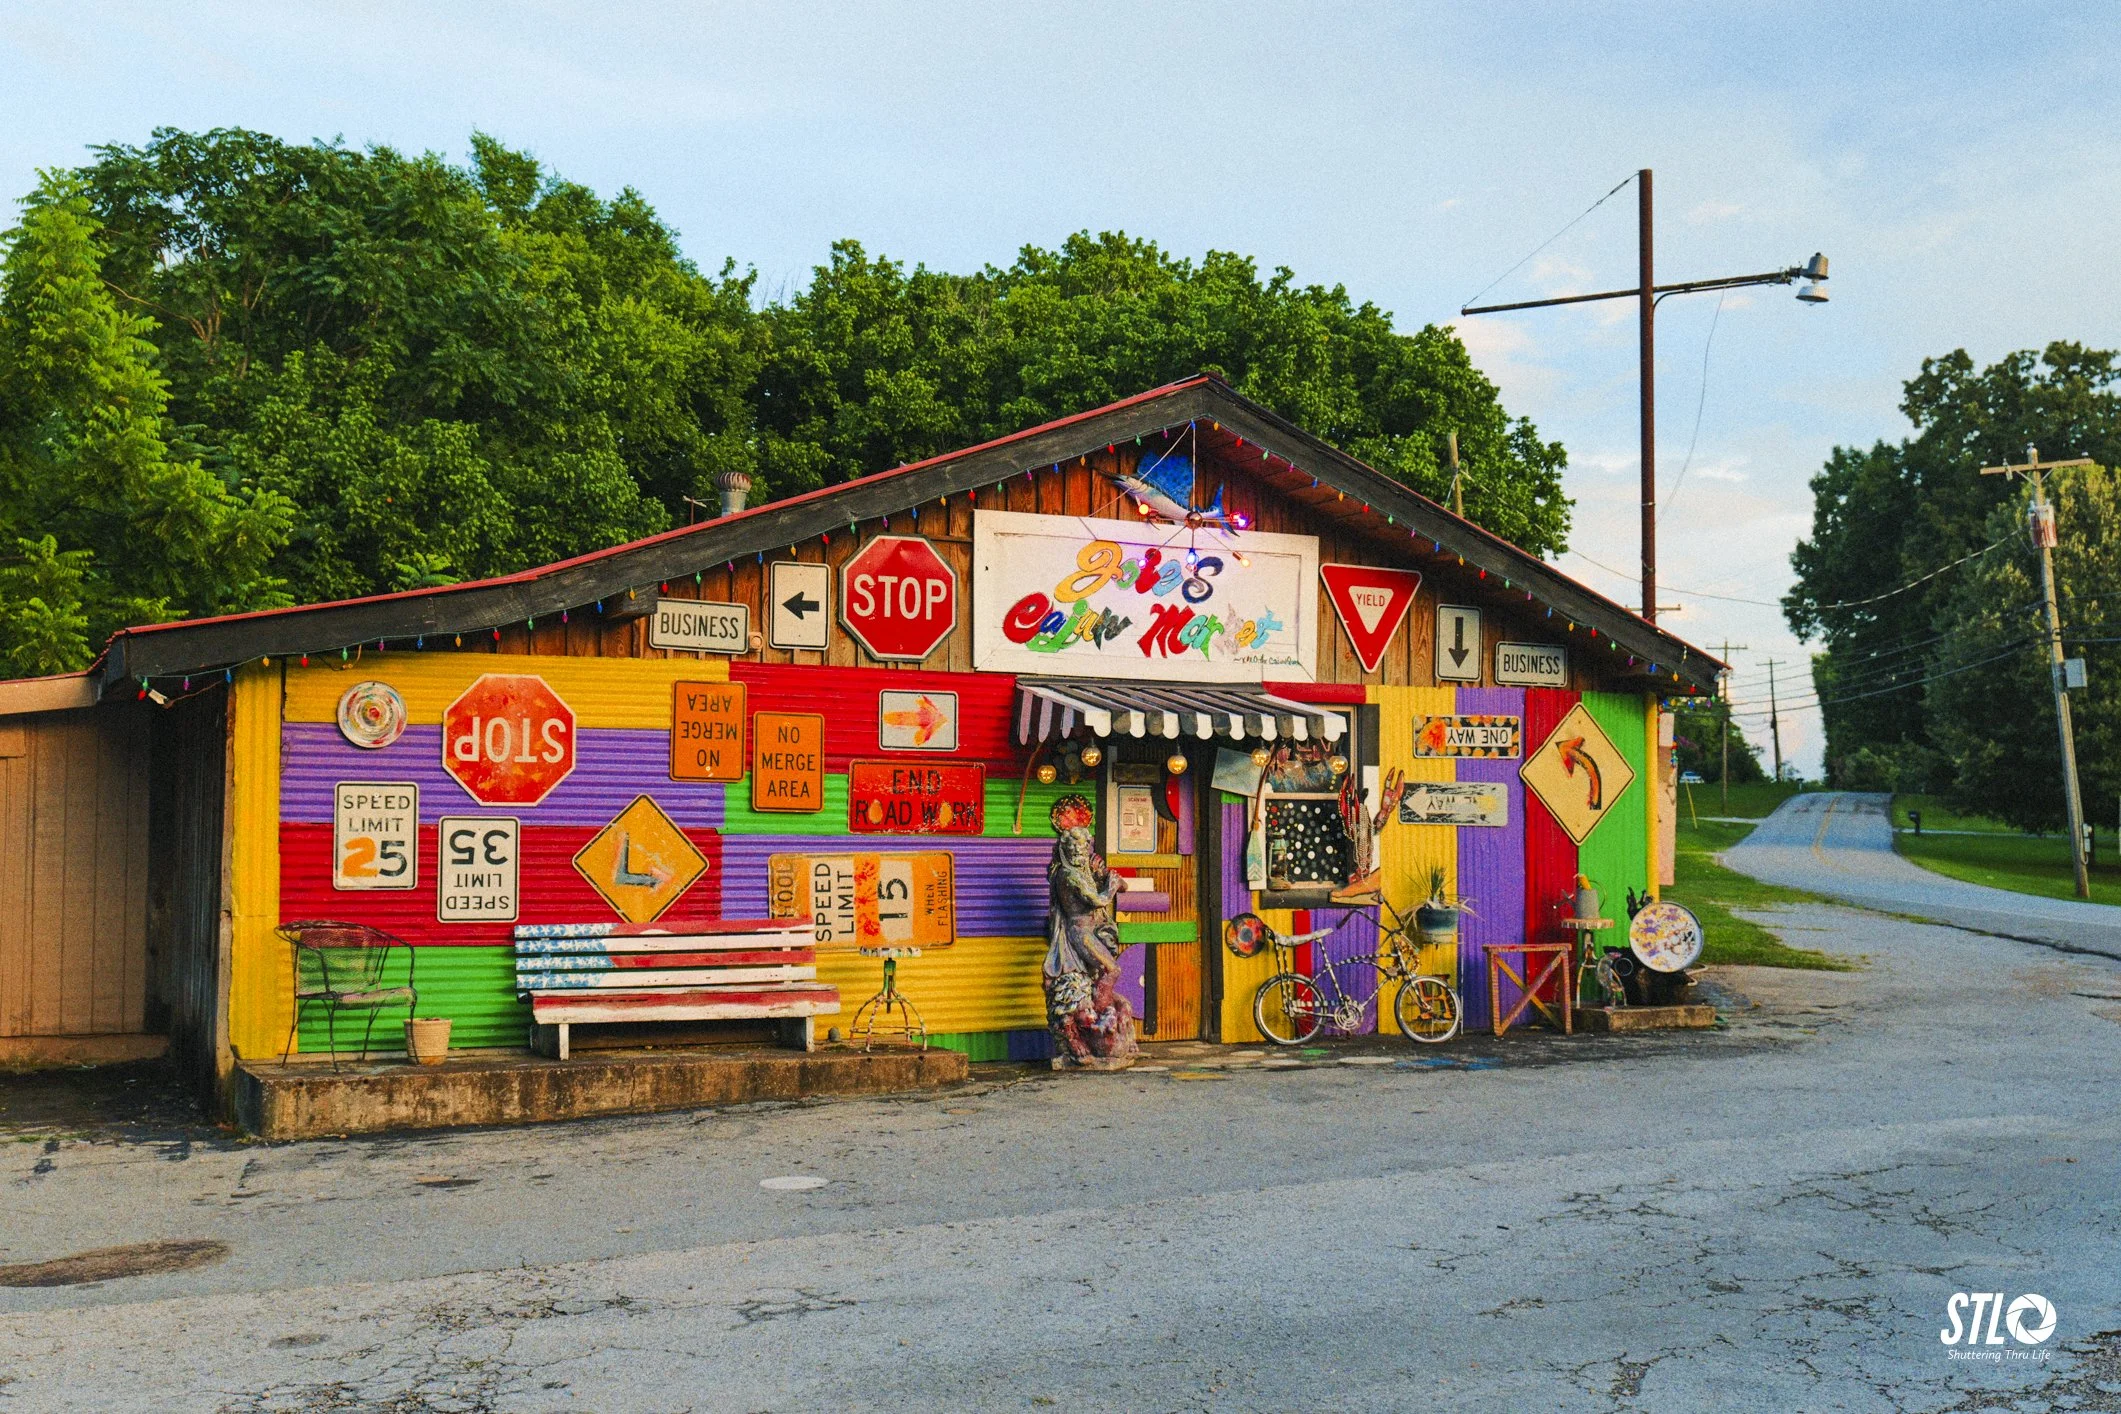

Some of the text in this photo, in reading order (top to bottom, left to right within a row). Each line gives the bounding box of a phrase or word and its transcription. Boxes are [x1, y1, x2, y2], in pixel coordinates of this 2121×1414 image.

[853, 574, 947, 621] STOP
[1356, 593, 1386, 607] YIELD
[661, 612, 739, 640] BUSINESS
[1503, 653, 1560, 675] BUSINESS
[687, 693, 732, 713] AREA
[454, 716, 567, 764] STOP
[681, 721, 738, 740] MERGE
[778, 726, 800, 744] NO
[1447, 728, 1509, 744] ONE WAY
[697, 750, 720, 767] NO
[762, 752, 816, 772] MERGE
[767, 780, 810, 799] AREA
[893, 769, 942, 795] END
[343, 795, 411, 810] SPEED
[855, 799, 979, 827] RAD WRK
[348, 817, 404, 832] LIMIT
[342, 835, 408, 878] 25
[450, 829, 510, 865] 35
[453, 873, 502, 888] LIMIT
[446, 895, 510, 910] SPEED
[814, 863, 832, 942] SPEED
[837, 870, 855, 935] LIMIT
[877, 878, 908, 922] 15
[925, 883, 935, 916] WHEN
[937, 870, 948, 927] FLASHING
